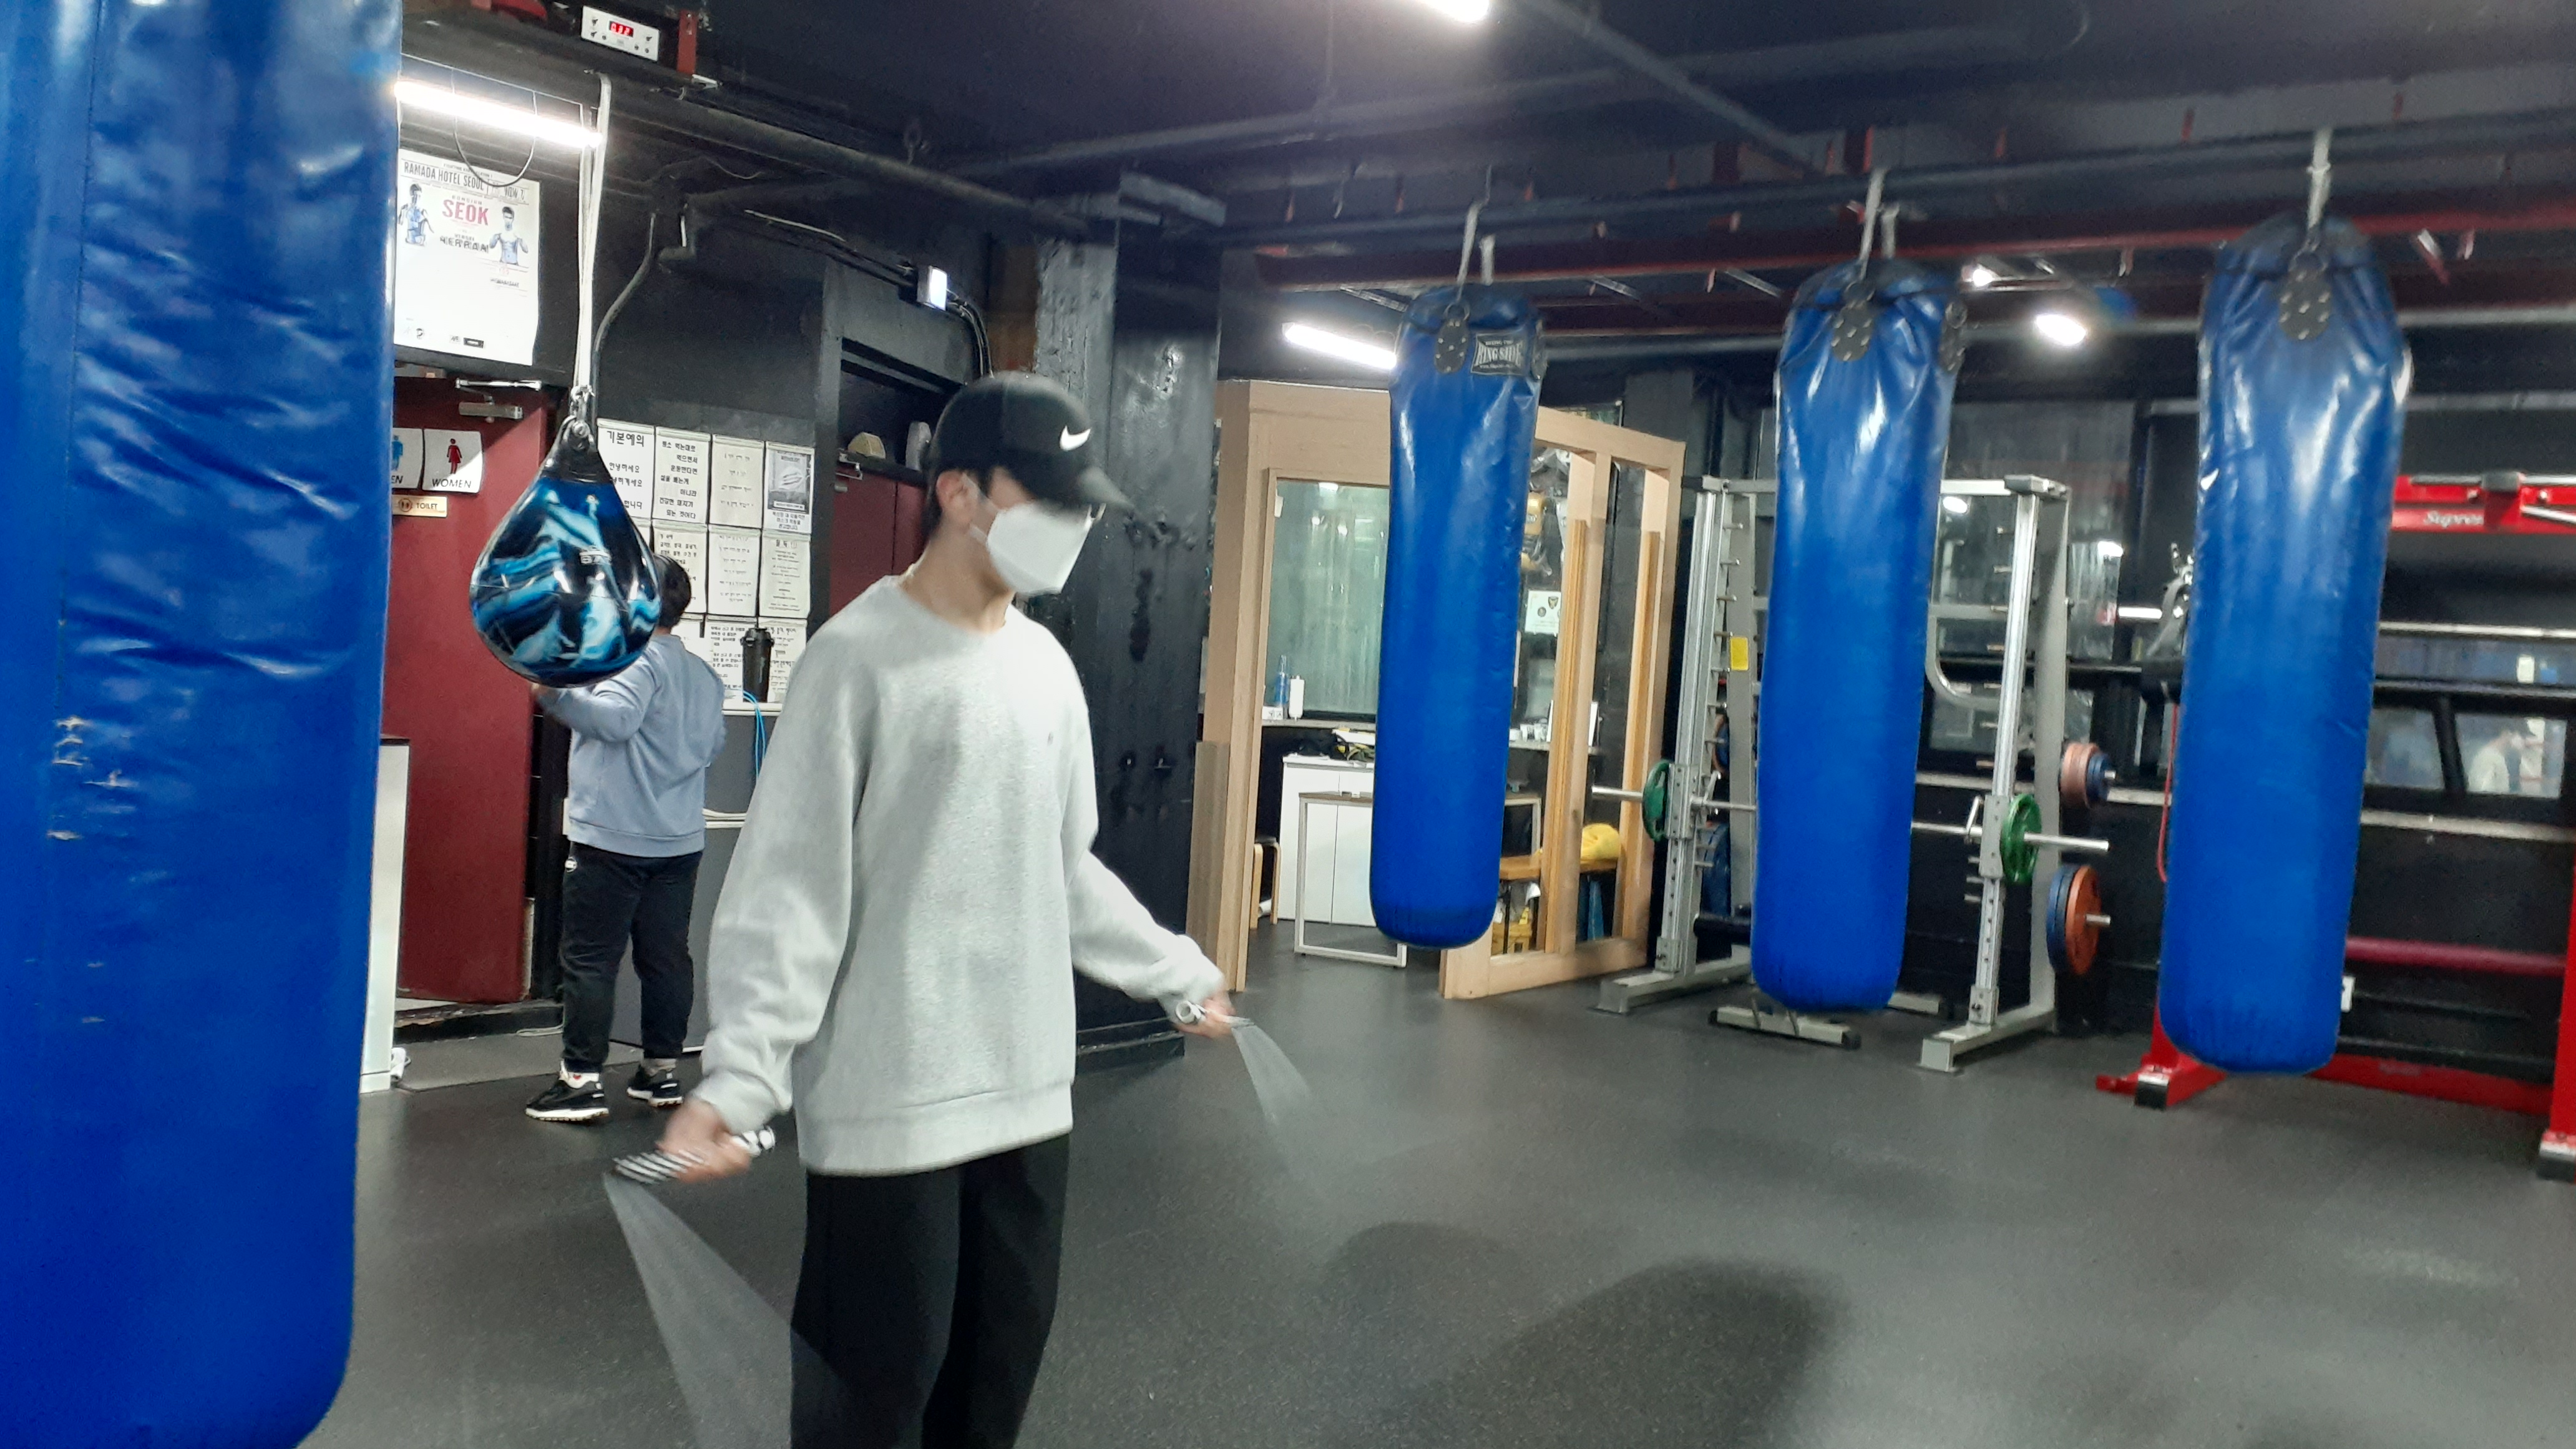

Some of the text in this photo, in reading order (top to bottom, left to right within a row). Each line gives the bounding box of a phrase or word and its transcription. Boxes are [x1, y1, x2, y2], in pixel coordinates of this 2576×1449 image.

[404, 162, 436, 179] RAMADA
[438, 171, 461, 185] HOTEL
[464, 175, 484, 191] SEOUL
[442, 199, 489, 225] SEOK
[607, 431, 644, 447] 기본예의
[609, 462, 640, 473] 안녕하세요
[391, 475, 472, 489] EN WOMEN
